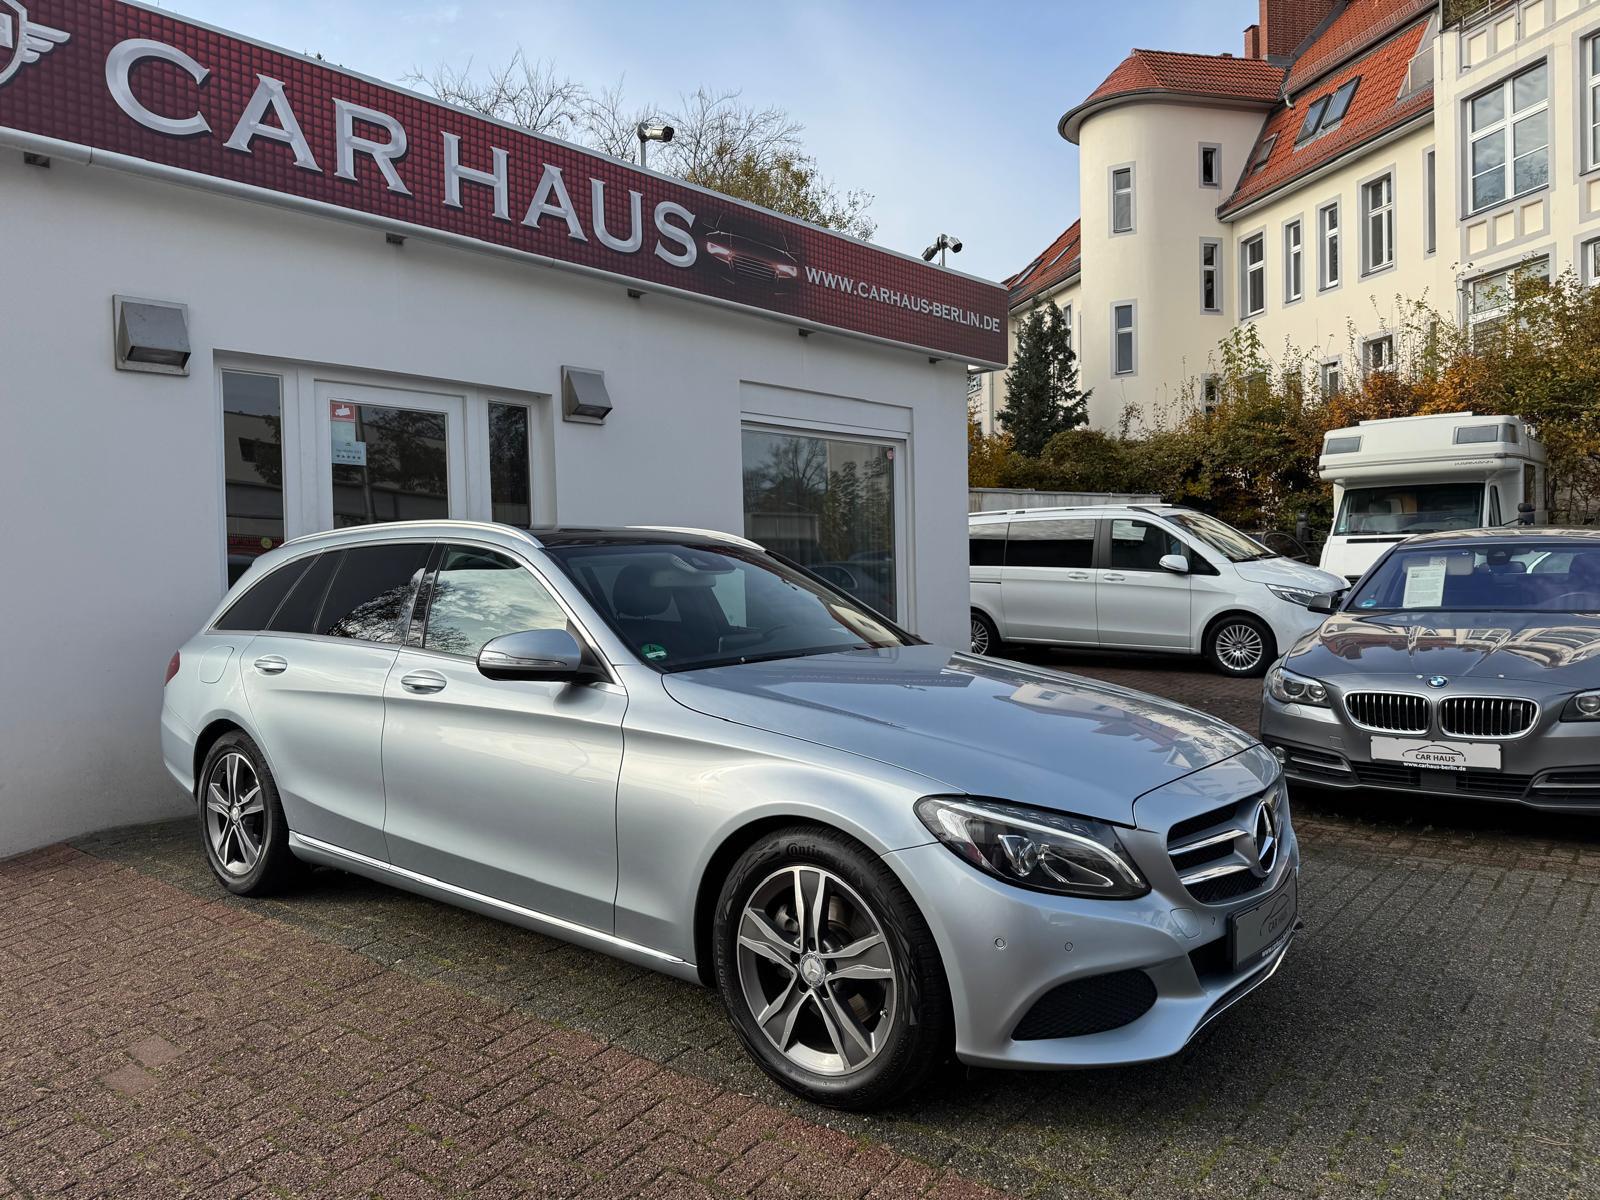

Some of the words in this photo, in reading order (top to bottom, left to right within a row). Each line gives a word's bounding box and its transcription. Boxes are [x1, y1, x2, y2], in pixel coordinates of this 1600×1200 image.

[105, 38, 412, 196] CAR
[441, 130, 698, 269] HAUS
[805, 266, 1001, 333] WWW.CARHAUS-BERLIN.DE
[1403, 762, 1466, 771] www.carhaus-berlin.de
[1415, 753, 1431, 761] CAR
[1433, 755, 1456, 763] HAUS
